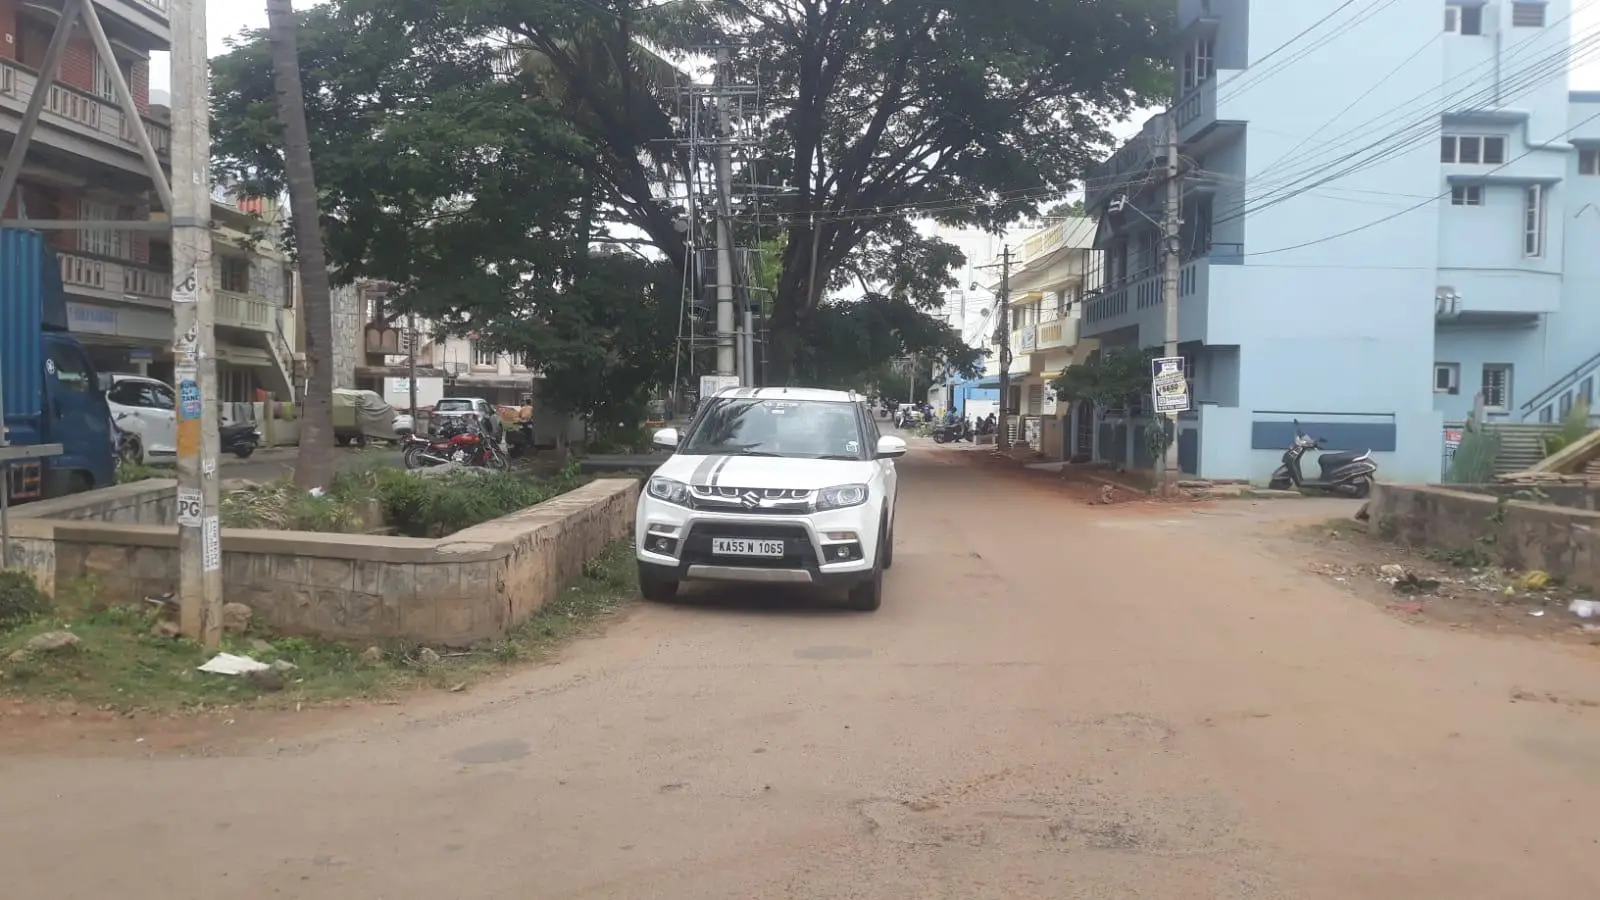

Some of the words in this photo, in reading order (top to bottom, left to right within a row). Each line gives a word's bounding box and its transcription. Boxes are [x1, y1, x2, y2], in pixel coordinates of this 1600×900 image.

[179, 500, 200, 517] PG
[719, 541, 745, 553] KA55
[747, 542, 754, 553] N
[759, 543, 783, 554] 1065
